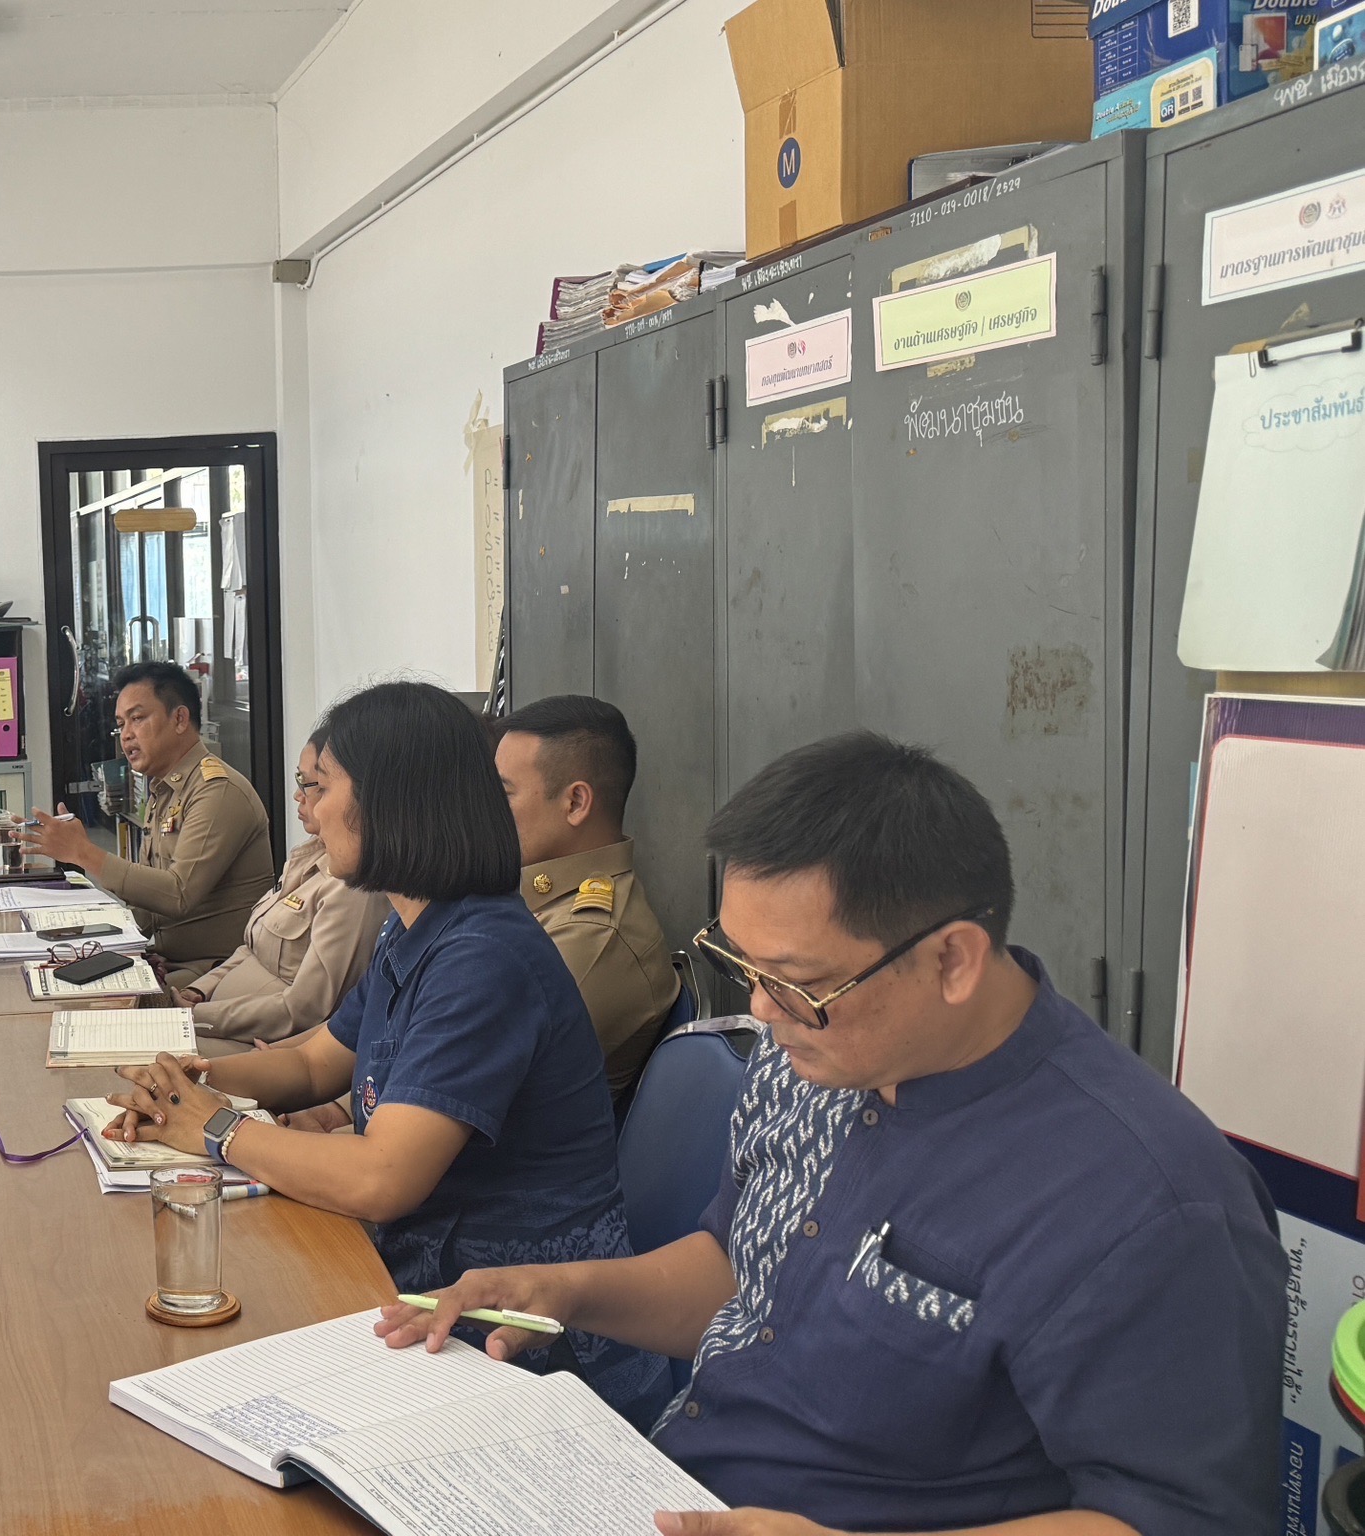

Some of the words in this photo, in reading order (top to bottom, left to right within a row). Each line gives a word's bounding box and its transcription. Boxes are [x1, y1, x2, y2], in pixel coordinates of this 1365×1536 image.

[1161, 104, 1174, 118] QR
[782, 148, 795, 178] M
[1220, 229, 1365, 279] มาตรฐานการพัฒนาชุม
[893, 319, 978, 351] งานด้านเศรษฐกิจ
[988, 306, 1038, 331] เศรษฐกิจ
[903, 390, 1024, 448] พัฒนาชุมชน
